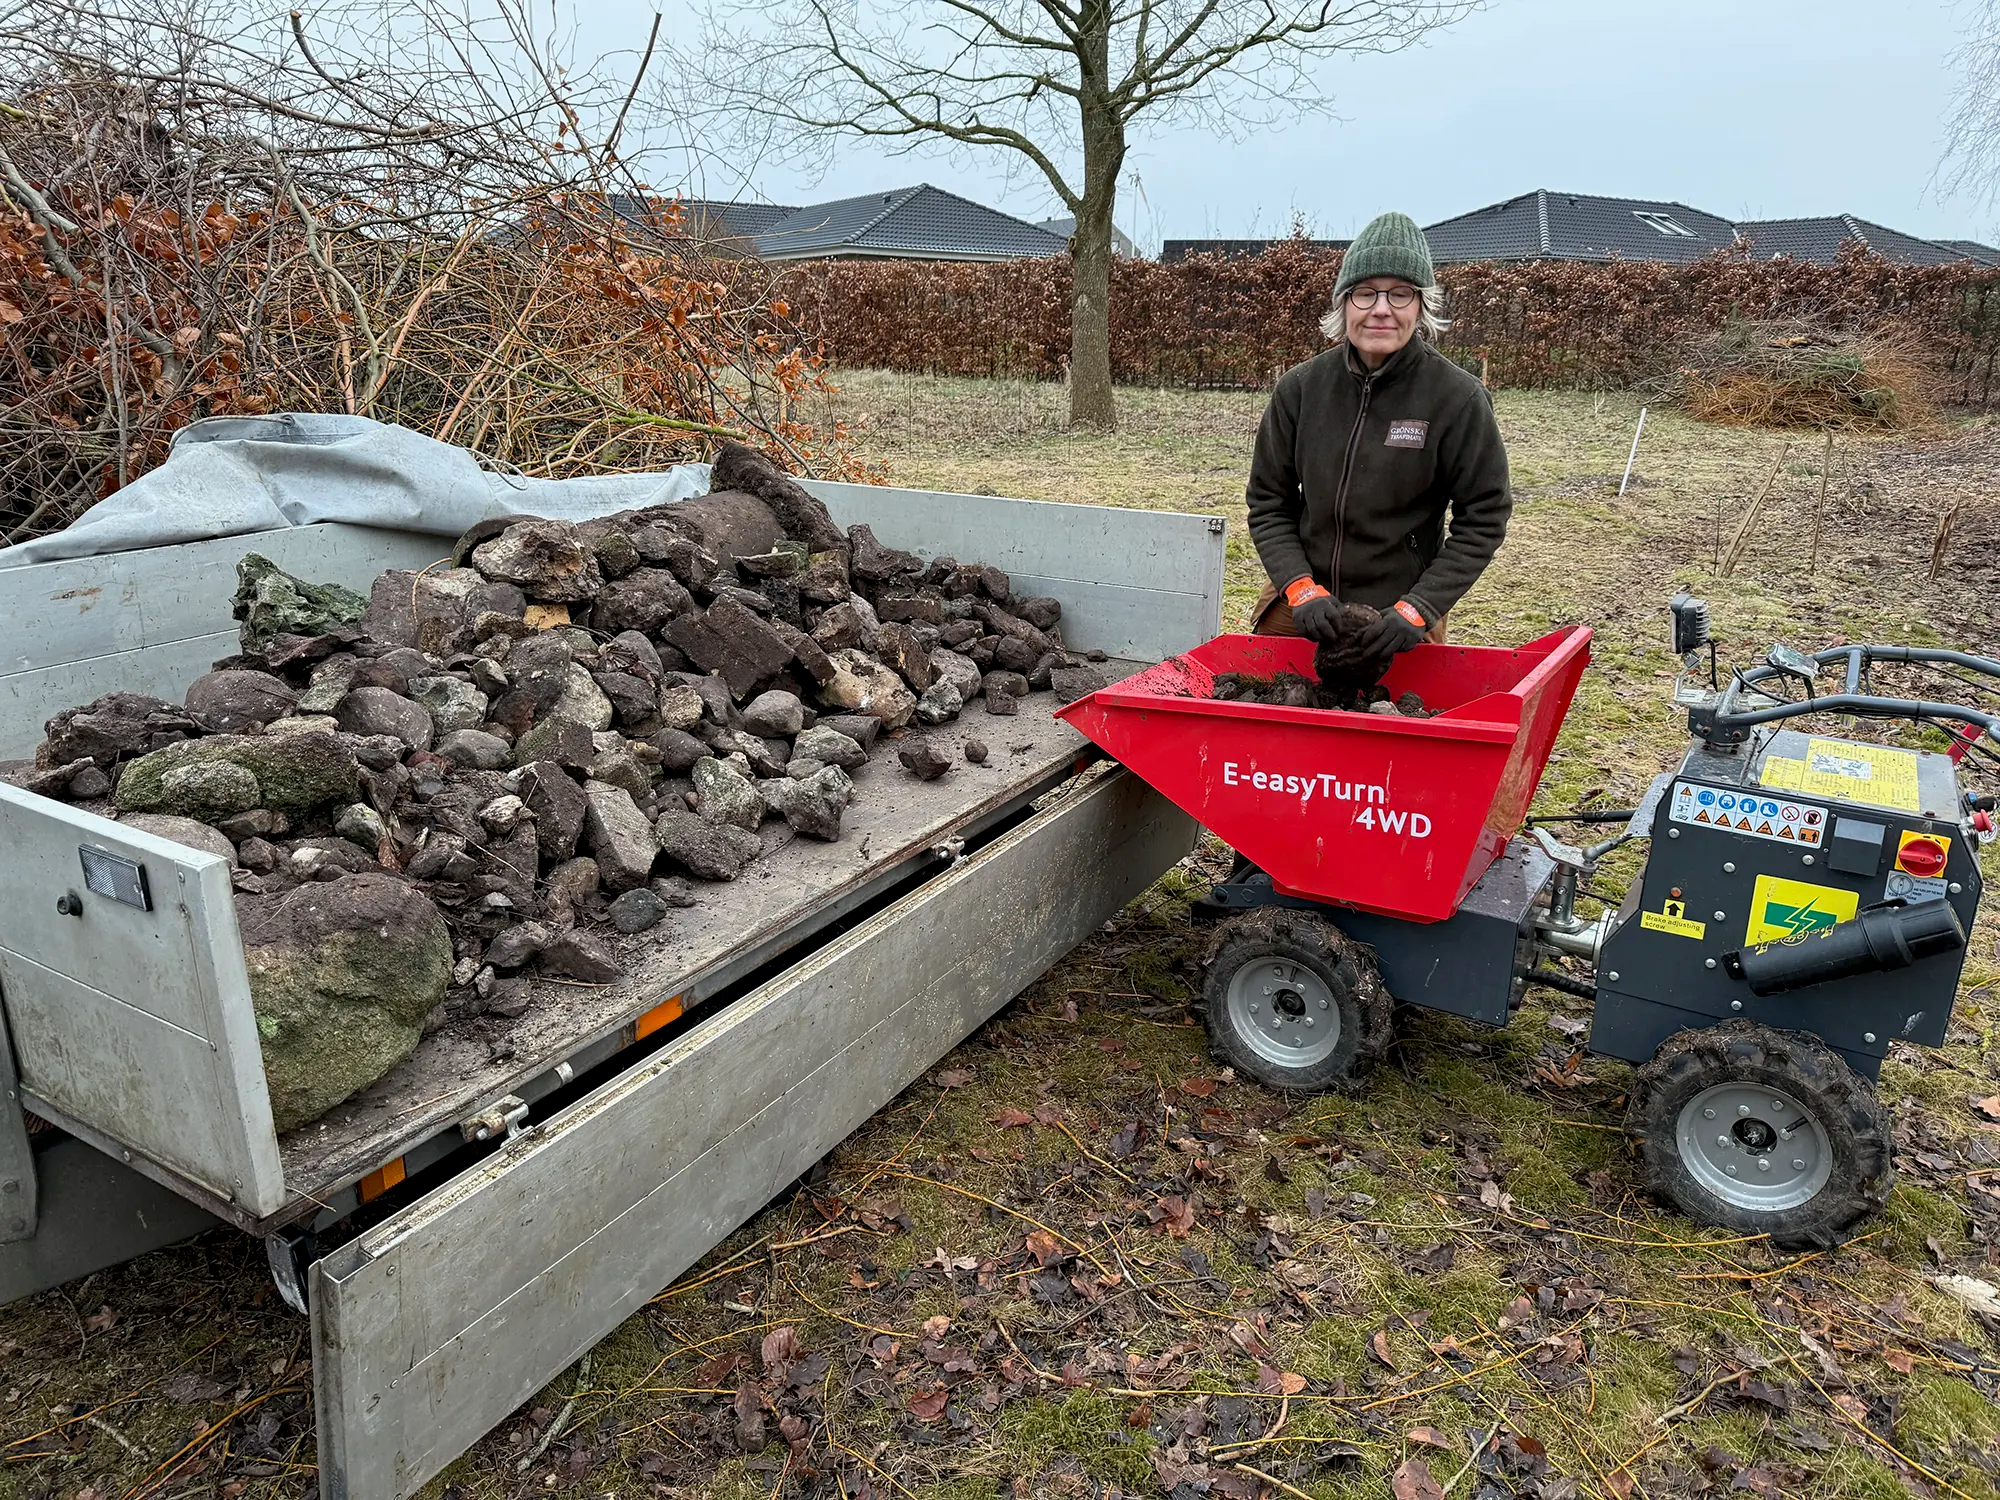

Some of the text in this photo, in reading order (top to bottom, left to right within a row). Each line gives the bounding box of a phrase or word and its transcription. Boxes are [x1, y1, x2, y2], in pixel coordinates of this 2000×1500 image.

[1223, 761, 1385, 804] E-easyTurn
[1355, 807, 1432, 838] 4WD
[1645, 914, 1700, 931] Brake adjusting
[1645, 922, 1666, 930] screw
